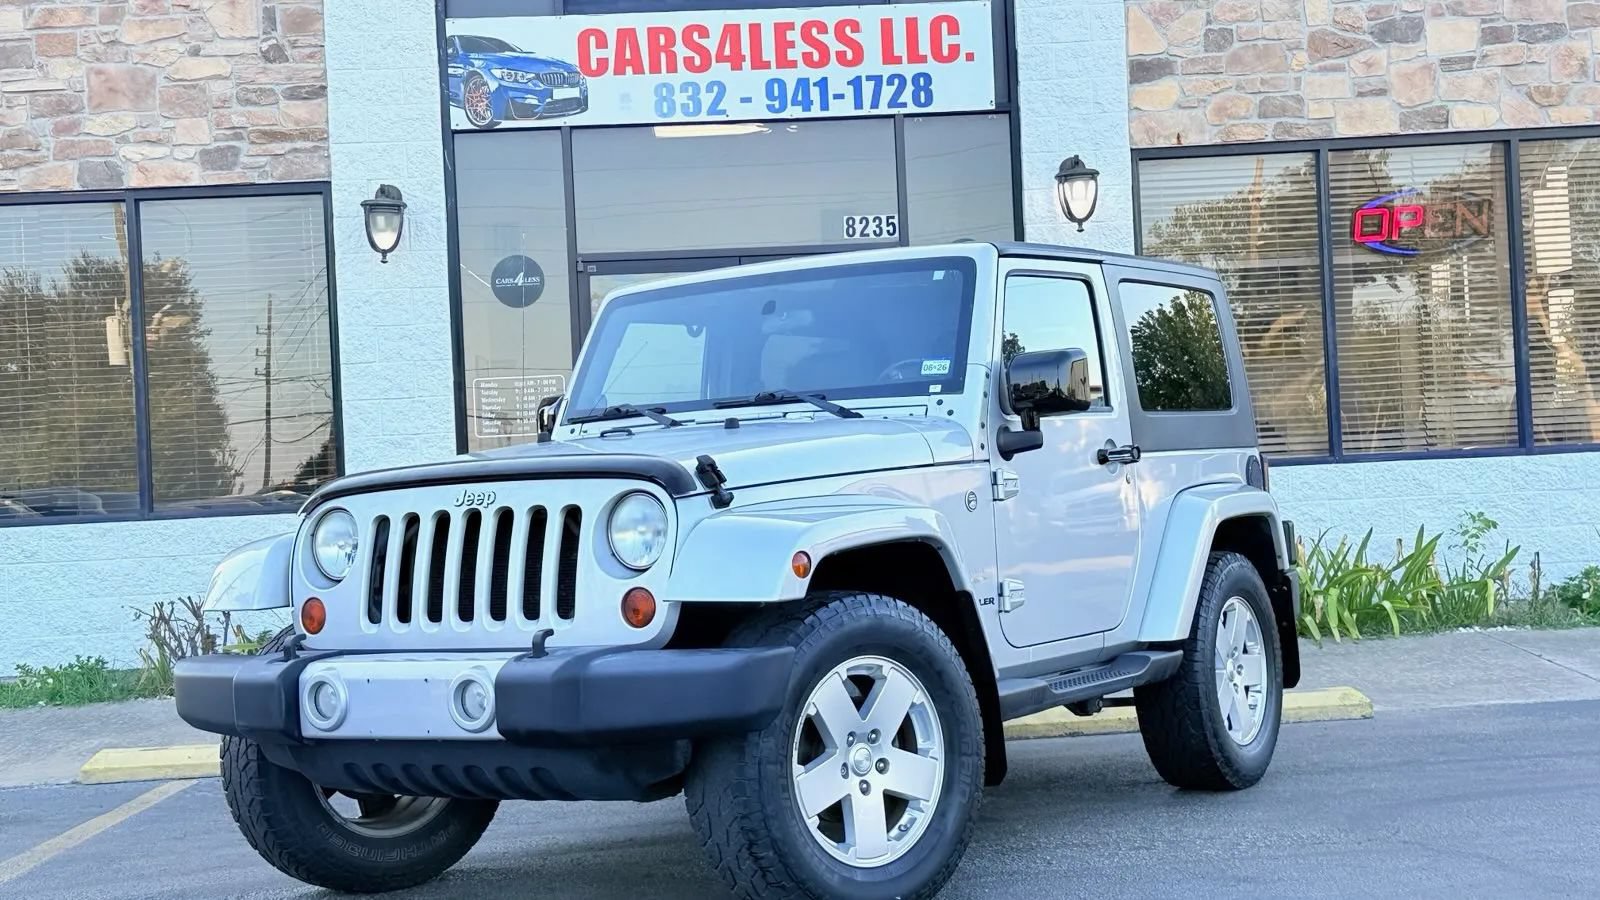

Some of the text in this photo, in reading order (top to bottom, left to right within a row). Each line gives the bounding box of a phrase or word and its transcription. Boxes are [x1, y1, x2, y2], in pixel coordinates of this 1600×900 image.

[577, 14, 975, 77] CARS4LESS LLC.
[654, 80, 727, 119] 832
[765, 72, 934, 114] 941-1728
[845, 215, 897, 238] 8235
[1354, 198, 1490, 244] OPEN
[454, 489, 497, 508] Jeep
